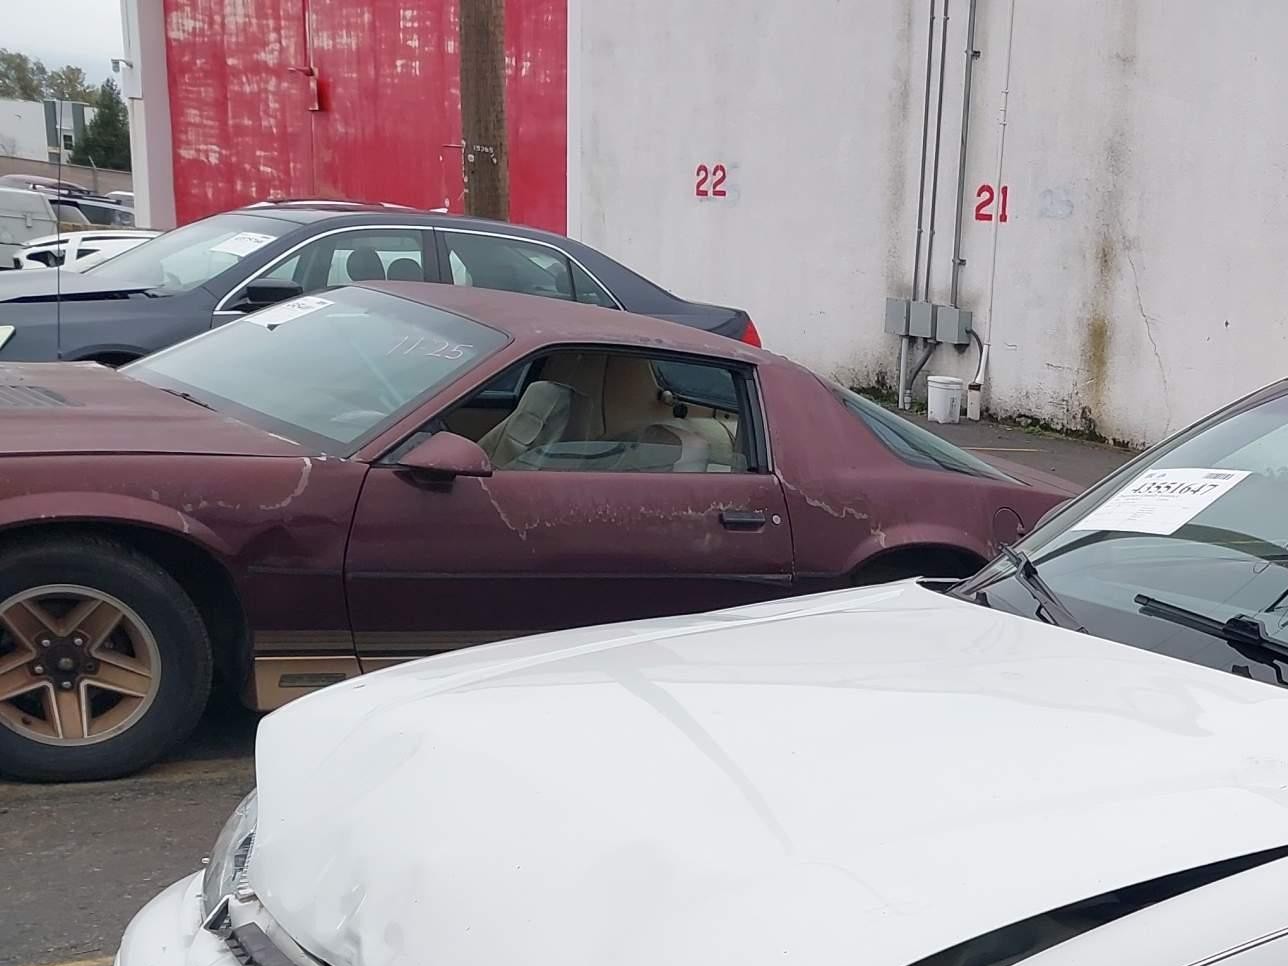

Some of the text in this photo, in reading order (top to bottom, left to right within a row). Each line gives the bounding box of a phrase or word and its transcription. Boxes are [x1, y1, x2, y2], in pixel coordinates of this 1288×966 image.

[695, 164, 727, 197] 22
[974, 184, 1009, 223] 21
[1131, 481, 1220, 496] 43551647
